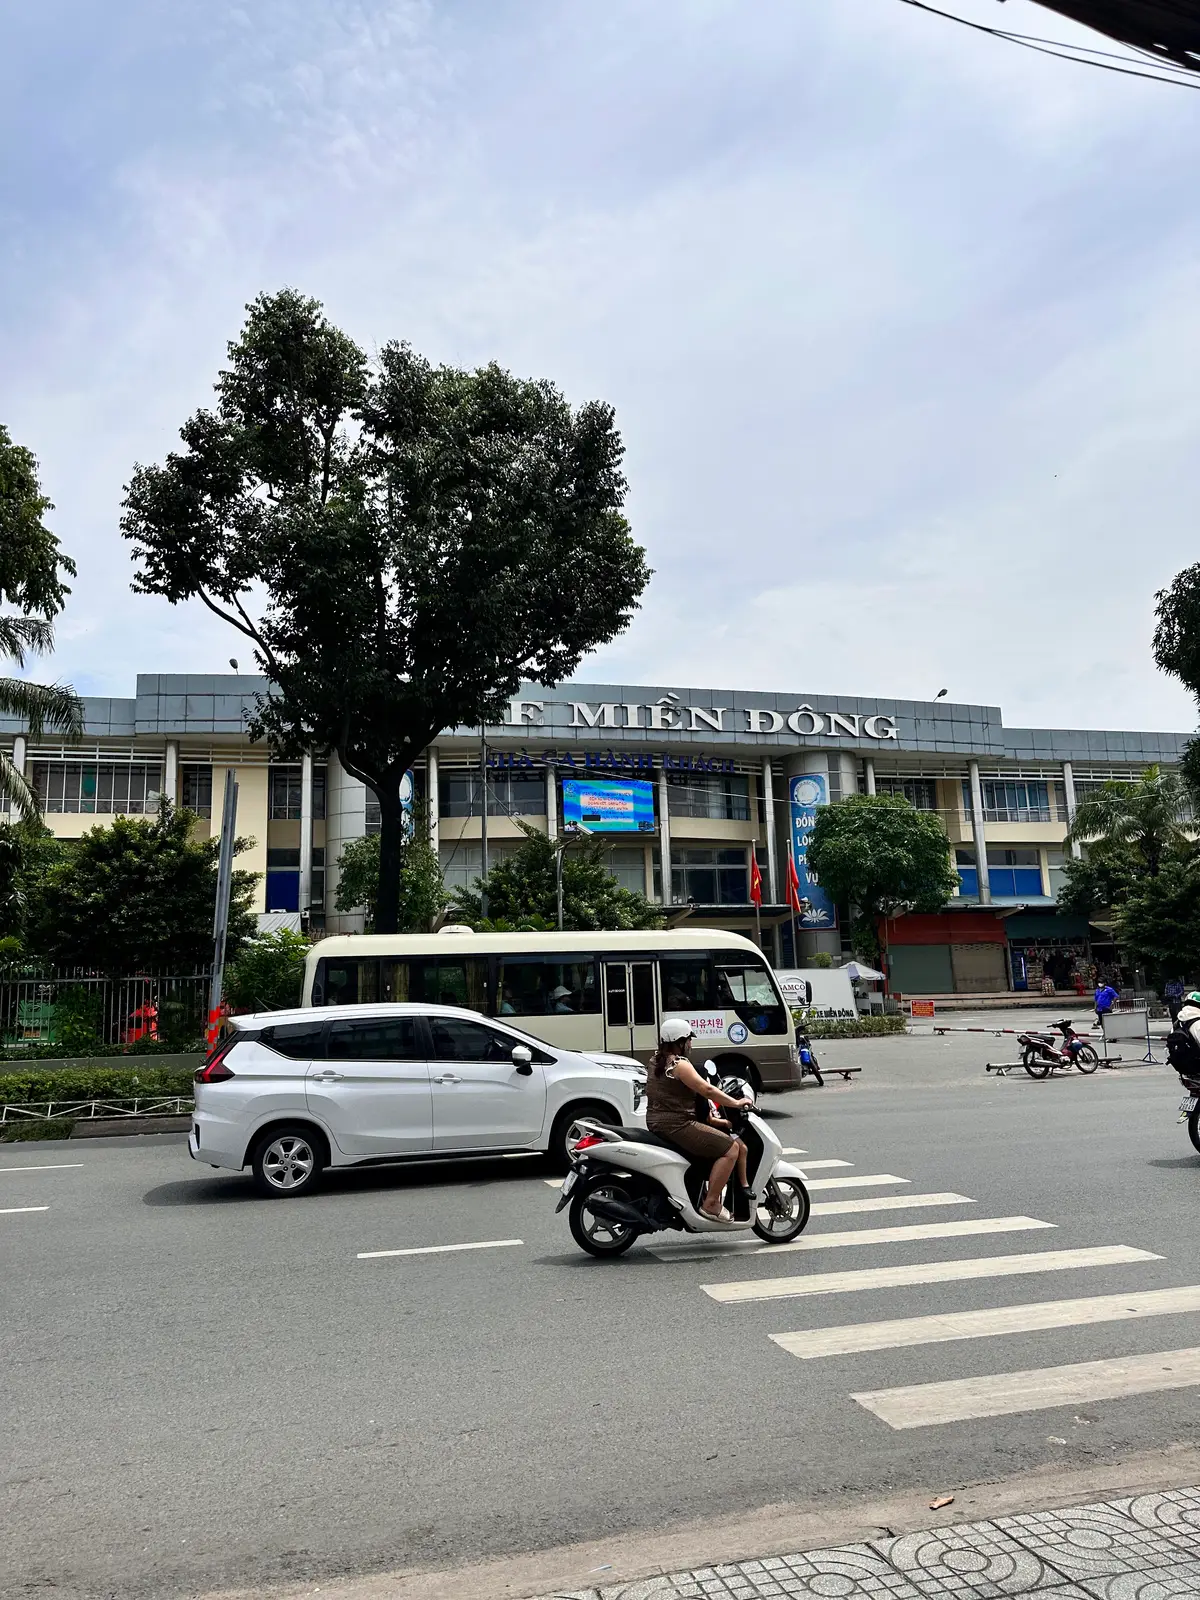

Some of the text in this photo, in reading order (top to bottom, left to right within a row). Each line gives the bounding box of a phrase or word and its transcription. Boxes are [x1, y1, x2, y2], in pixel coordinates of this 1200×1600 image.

[566, 692, 727, 731] MIỀN
[744, 703, 900, 739] ĐÔNG
[584, 748, 653, 768] HÀNH
[660, 753, 736, 772] KHÁCH
[795, 811, 816, 828] ĐỒN
[684, 1018, 723, 1029] 리유치원
